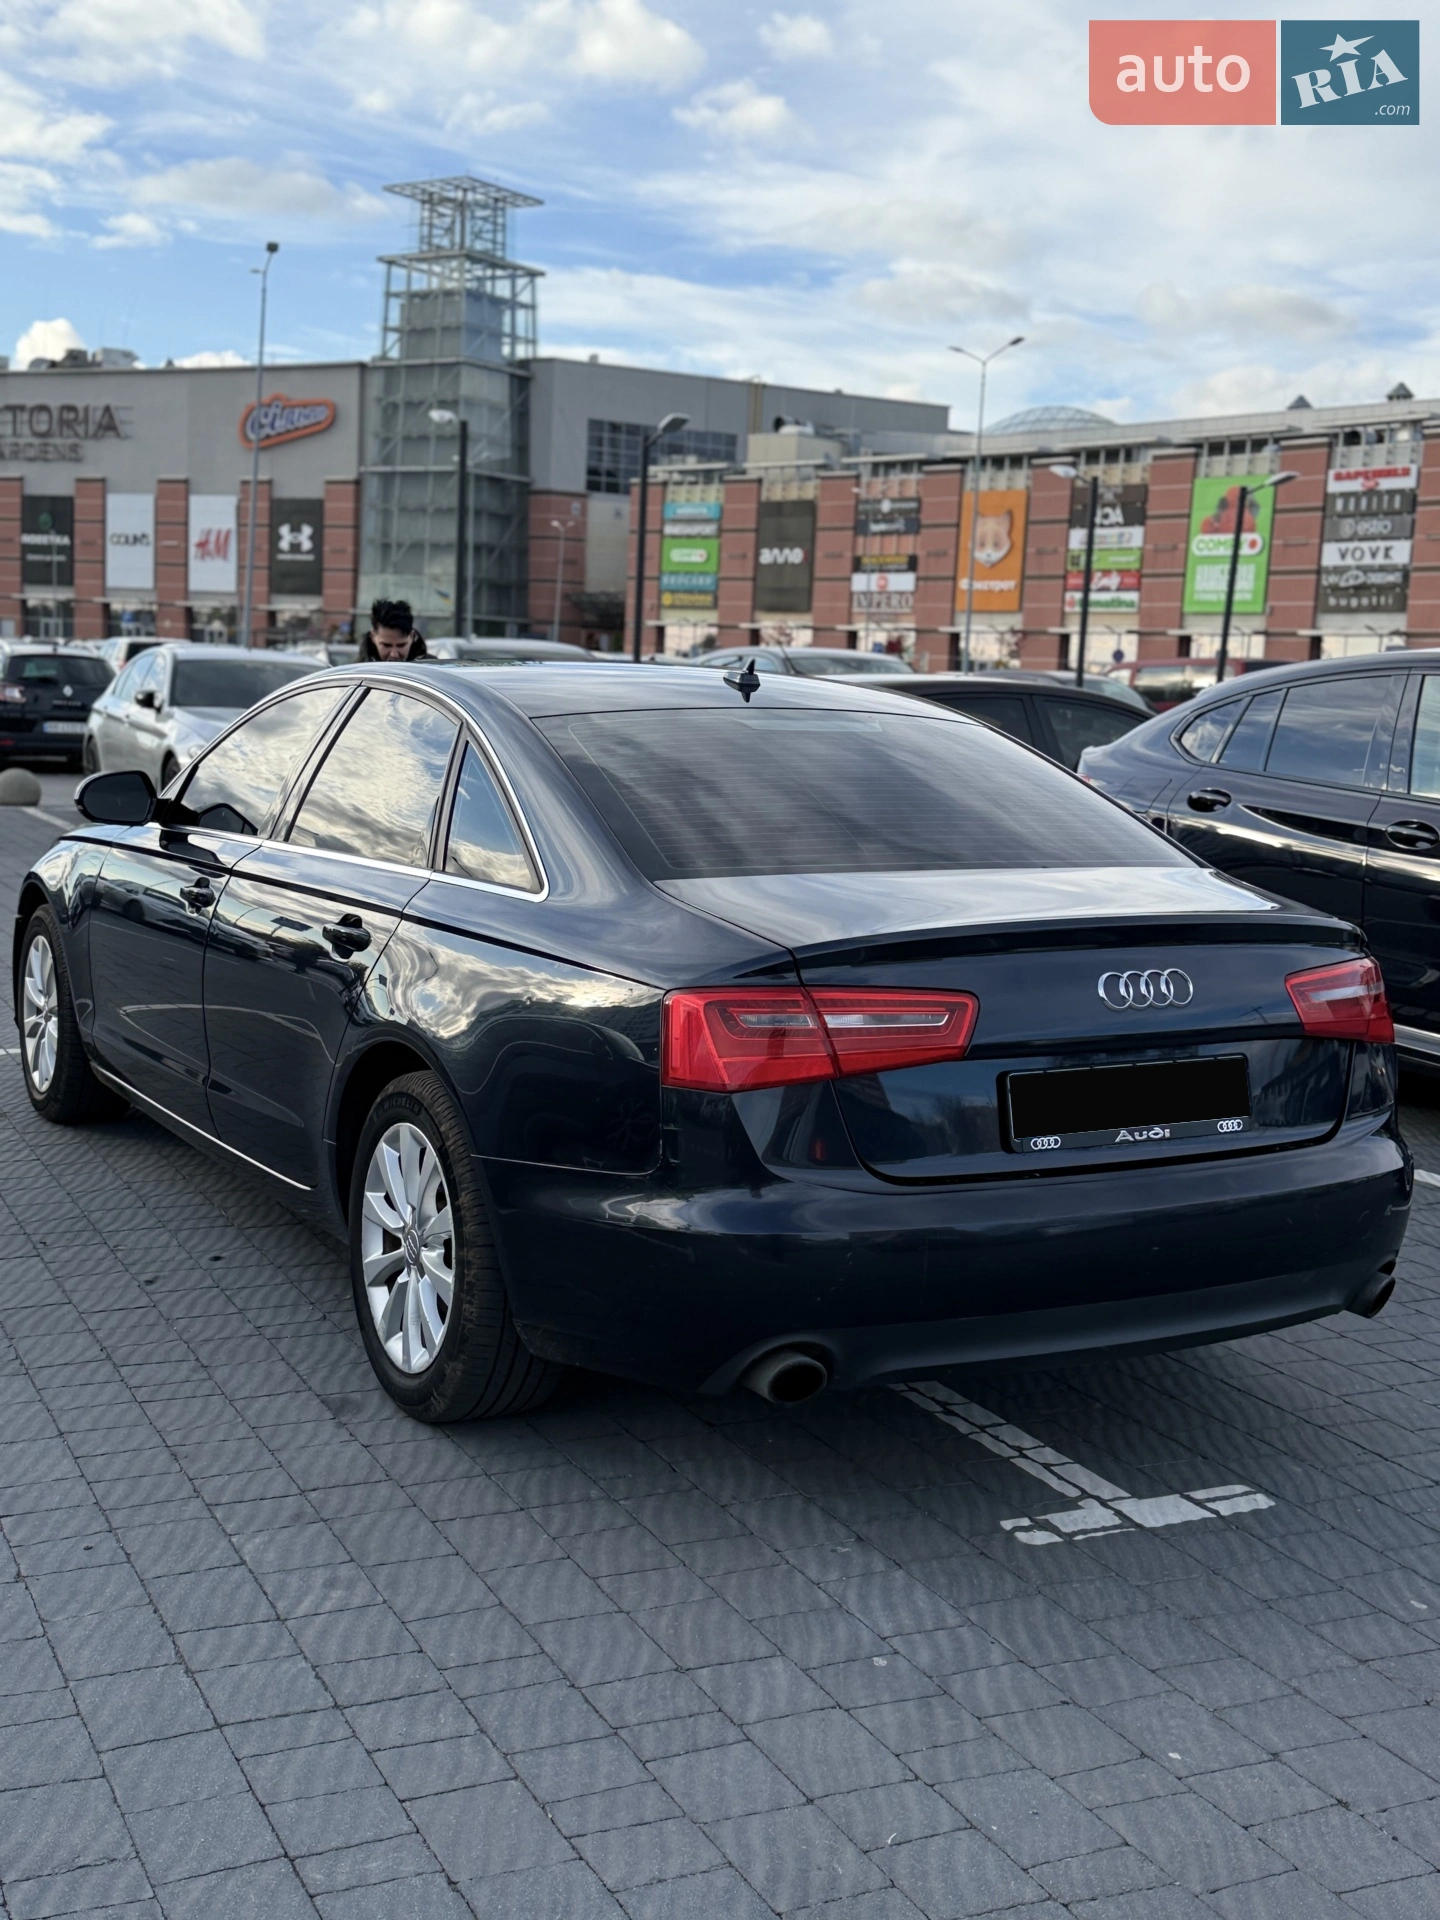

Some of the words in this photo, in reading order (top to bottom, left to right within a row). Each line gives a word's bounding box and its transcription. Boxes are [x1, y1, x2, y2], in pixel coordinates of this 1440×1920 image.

[0, 404, 121, 438] TORIA
[1338, 545, 1395, 562] VOVK
[1115, 1126, 1171, 1143] Audi
